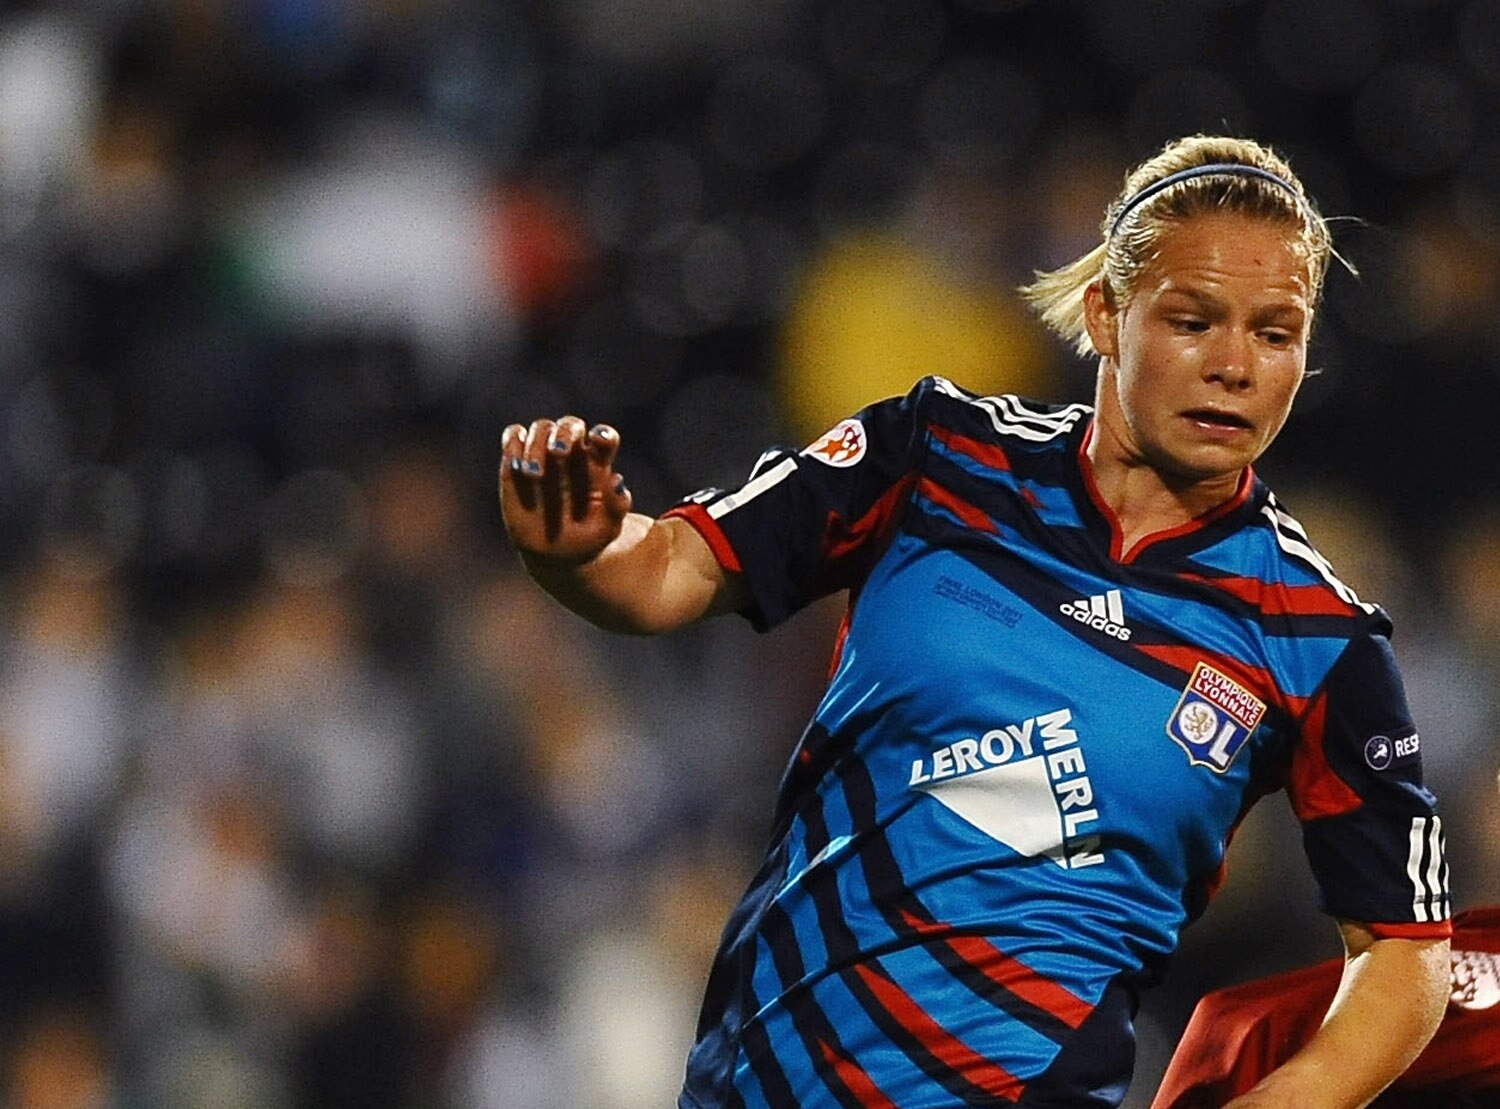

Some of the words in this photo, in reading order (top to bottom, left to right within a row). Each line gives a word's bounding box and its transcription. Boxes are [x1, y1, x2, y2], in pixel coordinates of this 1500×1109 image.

[1060, 603, 1132, 641] adidas
[1194, 678, 1257, 726] LYONNAIS
[1199, 668, 1261, 716] OLYMPIQUE
[908, 717, 1035, 786] LEROY
